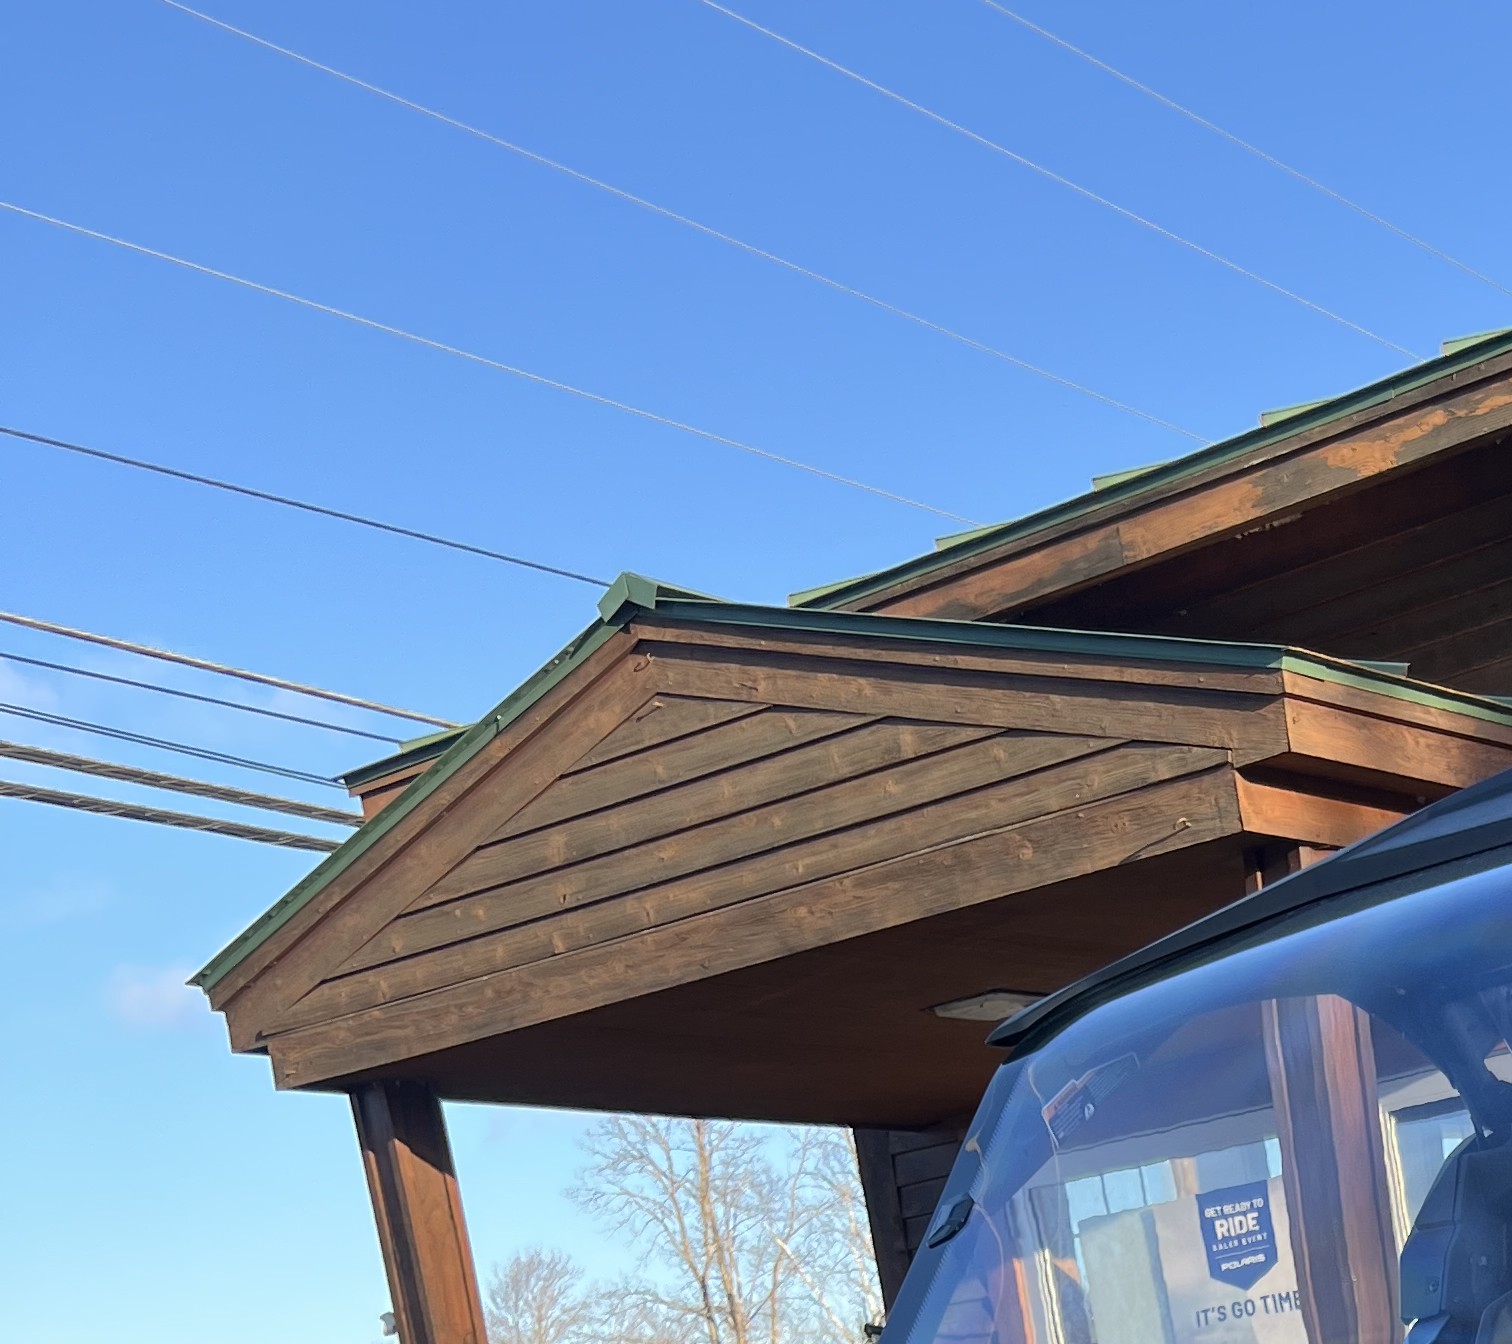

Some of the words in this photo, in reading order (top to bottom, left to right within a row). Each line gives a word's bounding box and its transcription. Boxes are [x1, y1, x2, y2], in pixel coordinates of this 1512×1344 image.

[1204, 1205, 1223, 1218] GET
[1223, 1200, 1251, 1215] READY
[1251, 1198, 1264, 1209] TO
[1214, 1212, 1260, 1240] RIDE
[1212, 1238, 1239, 1252] SALES
[1241, 1232, 1268, 1246] EVENT
[1221, 1254, 1266, 1271] POLARIS
[1196, 1305, 1227, 1328] IT'S
[1231, 1299, 1256, 1319] GO
[1260, 1290, 1301, 1315] TIME
